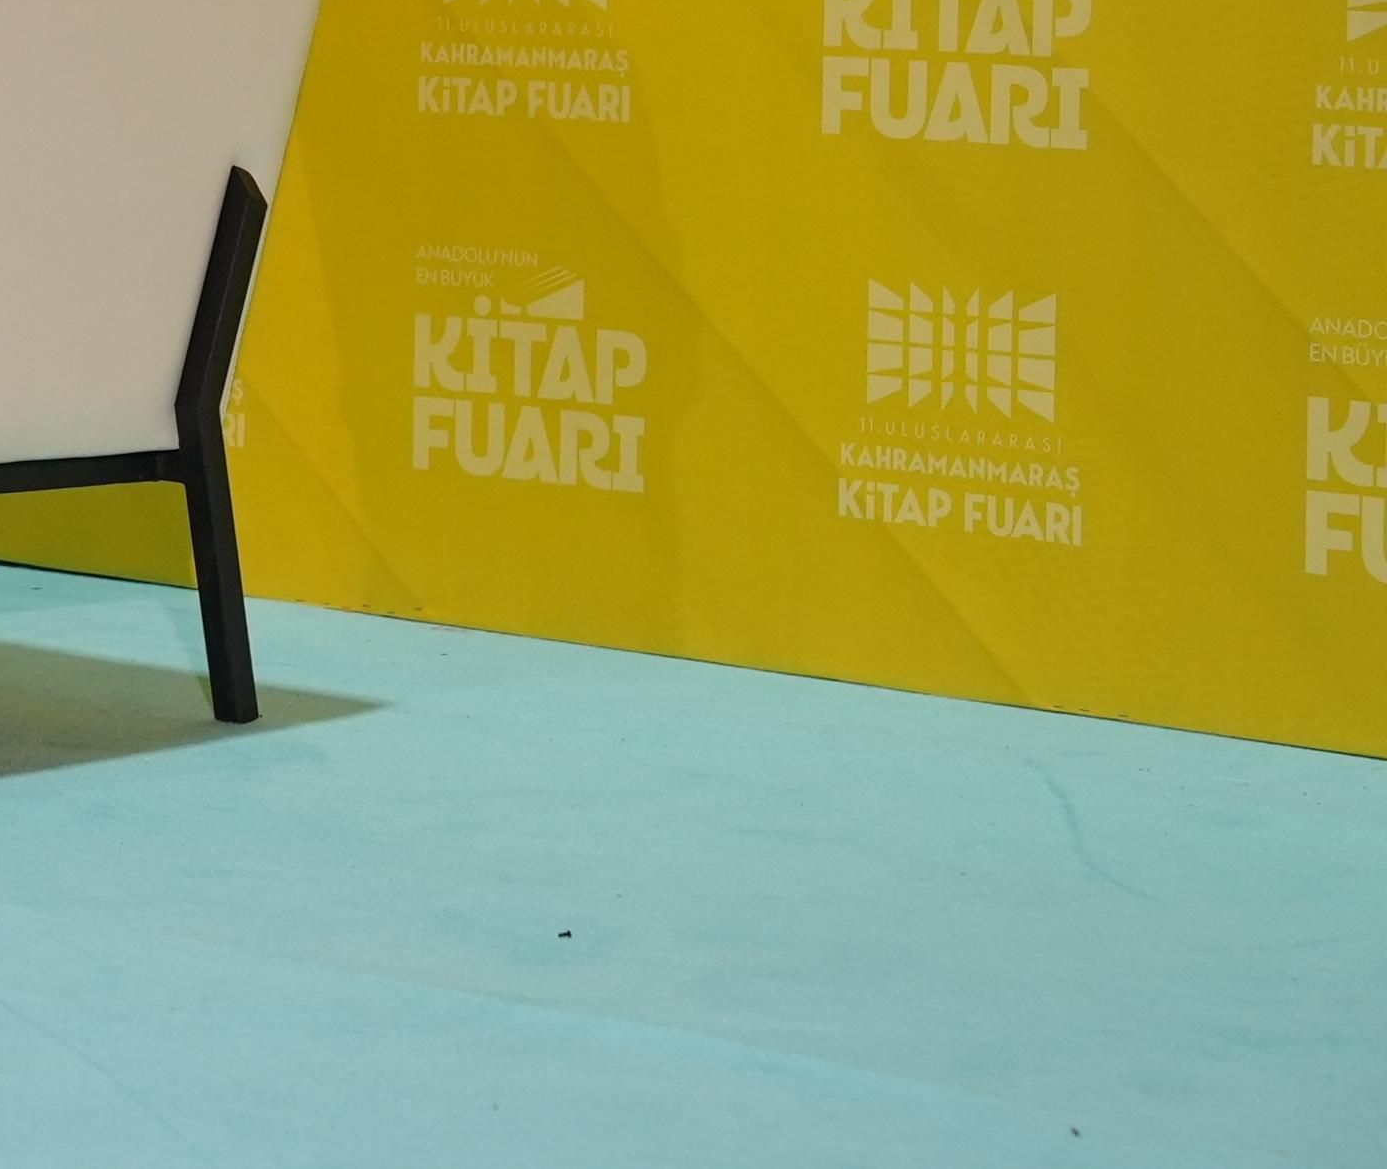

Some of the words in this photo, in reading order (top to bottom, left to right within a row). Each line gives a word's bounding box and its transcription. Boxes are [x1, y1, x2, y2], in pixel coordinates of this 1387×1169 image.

[418, 40, 630, 79] KAHRAMANMARAŞ
[527, 78, 634, 126] FUARI
[821, 55, 1090, 151] FUARI
[1308, 342, 1338, 363] EN
[411, 395, 647, 495] FUARI
[884, 418, 1063, 455] ULUSLARARASI
[840, 441, 1082, 498] KAHRAMANMARAŞ
[962, 490, 1084, 547] FUARI
